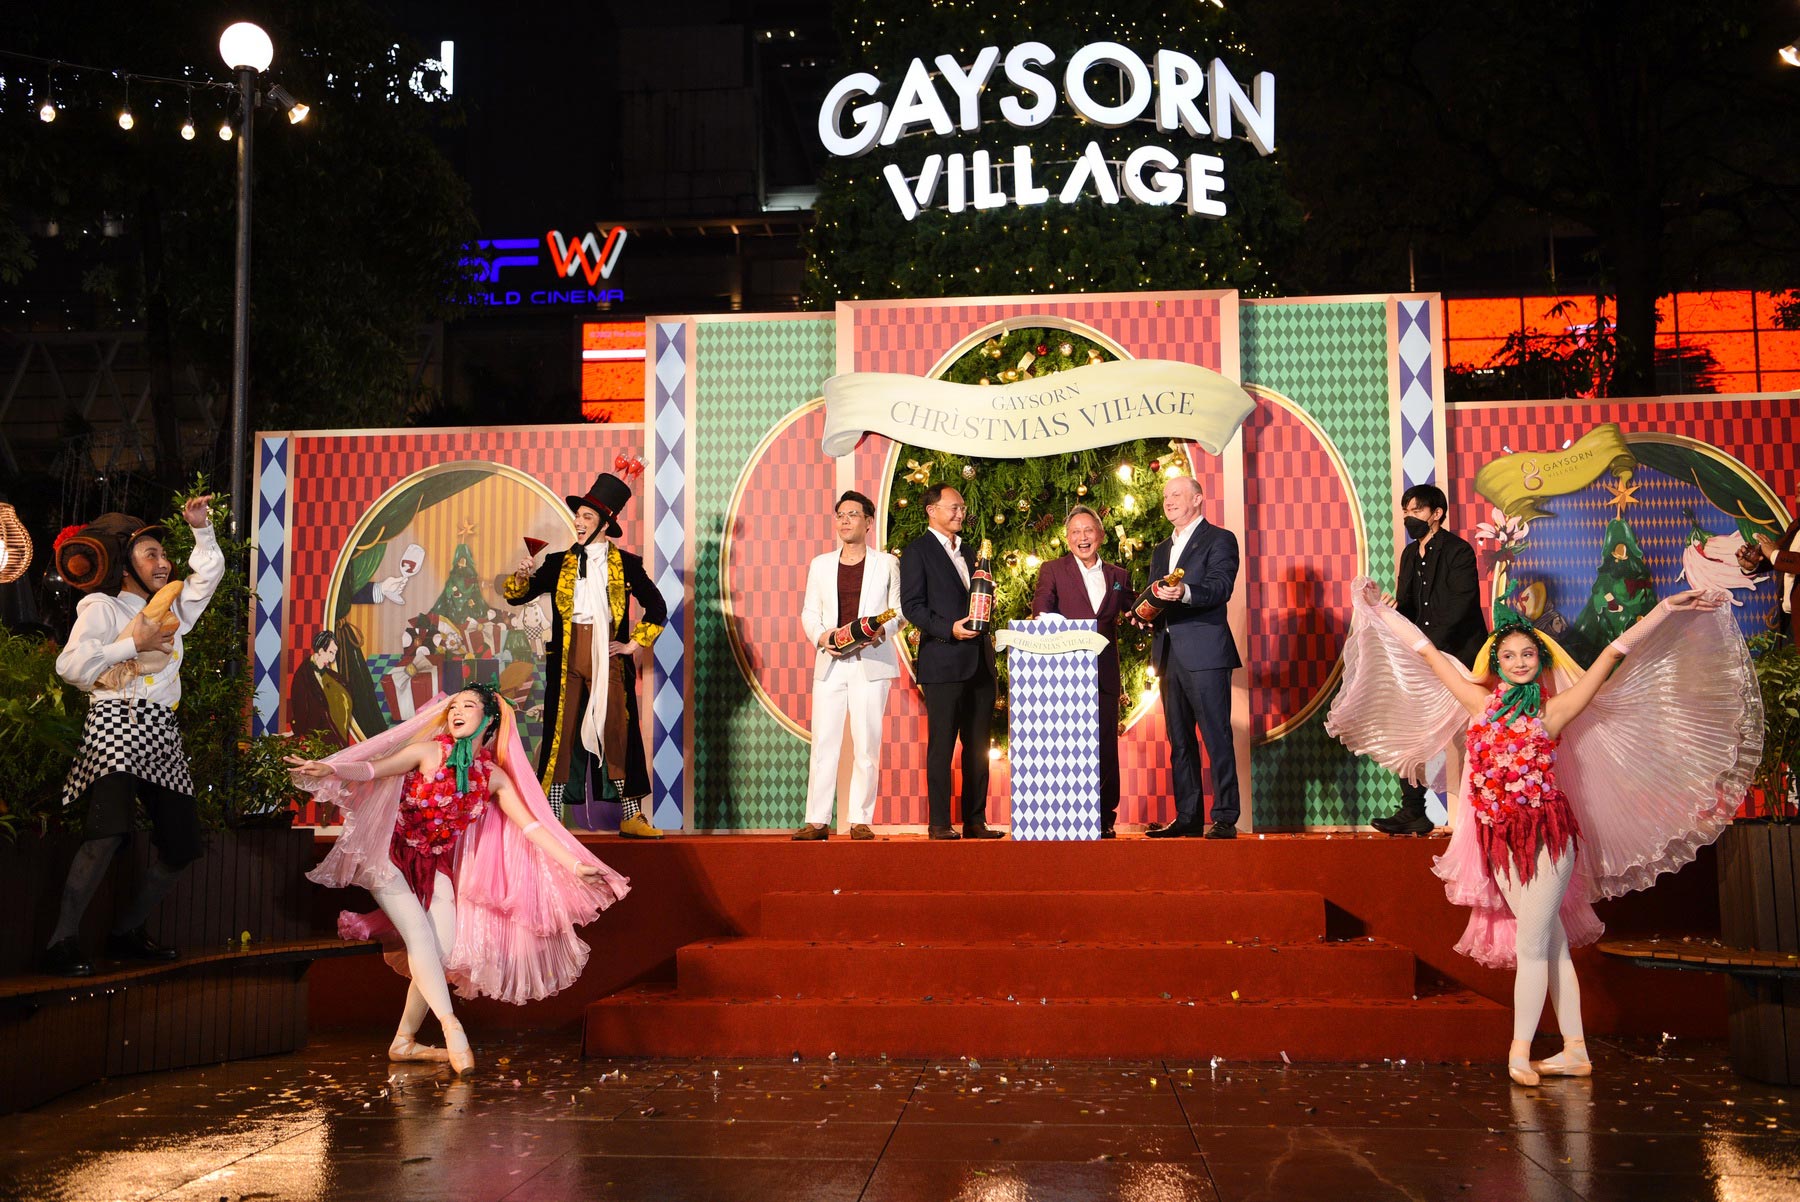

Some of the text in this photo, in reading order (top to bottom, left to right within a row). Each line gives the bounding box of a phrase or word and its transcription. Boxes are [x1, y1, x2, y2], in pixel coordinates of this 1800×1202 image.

[818, 41, 1275, 156] GAYSORN
[883, 141, 1227, 221] VILLAGE
[530, 289, 625, 304] CINEMA
[992, 382, 1081, 411] GAYSORN
[1079, 391, 1195, 428] VILLAGE
[1543, 450, 1593, 472] GAYSORN
